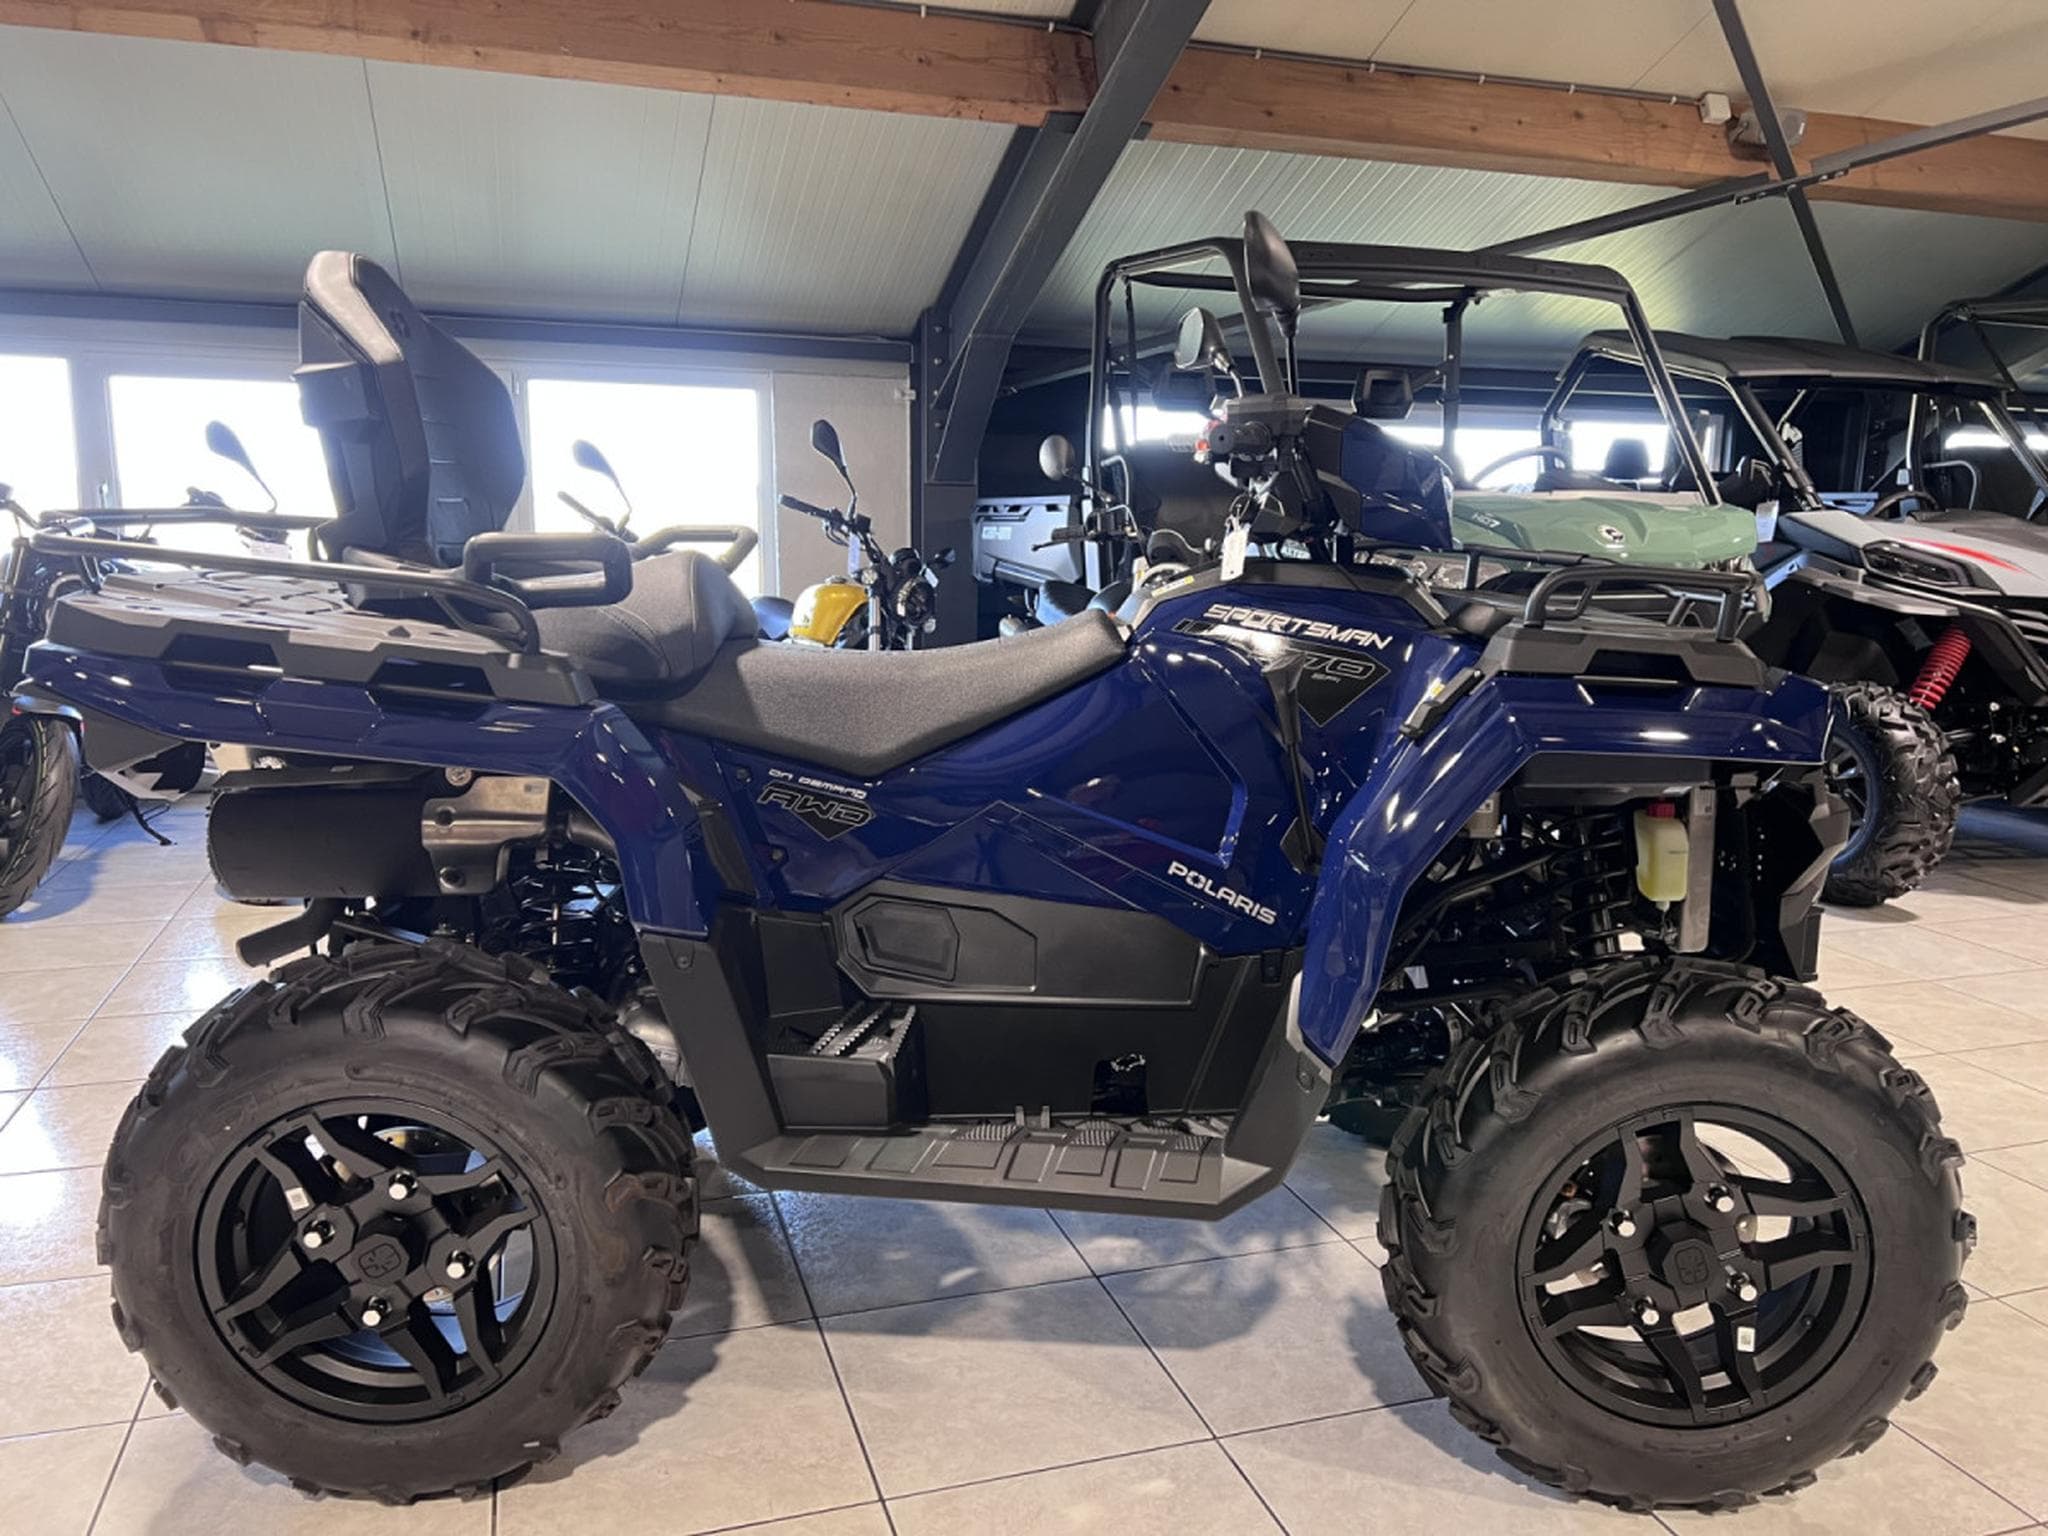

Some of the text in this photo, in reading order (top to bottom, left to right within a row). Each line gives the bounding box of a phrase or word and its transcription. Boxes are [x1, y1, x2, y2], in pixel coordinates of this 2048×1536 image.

[1203, 603, 1394, 651] SPORTSMAN
[756, 786, 873, 828] AWD
[798, 776, 868, 800] DEMAND
[1167, 860, 1278, 926] POLARIS
